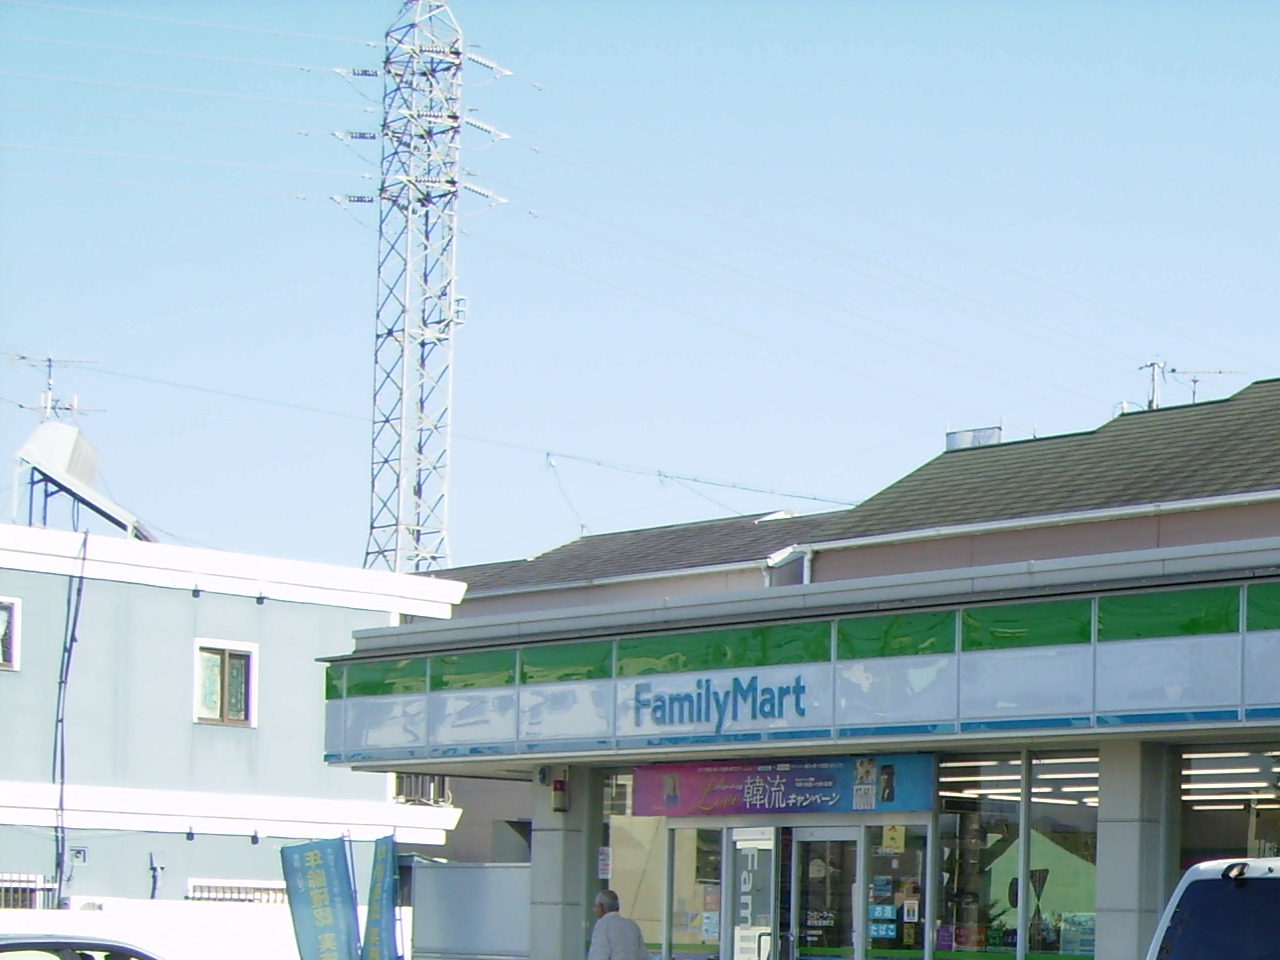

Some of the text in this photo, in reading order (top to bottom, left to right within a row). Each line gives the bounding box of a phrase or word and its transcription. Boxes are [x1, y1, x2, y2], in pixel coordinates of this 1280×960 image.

[634, 675, 806, 734] FamilyMart
[870, 924, 896, 936] たばこ
